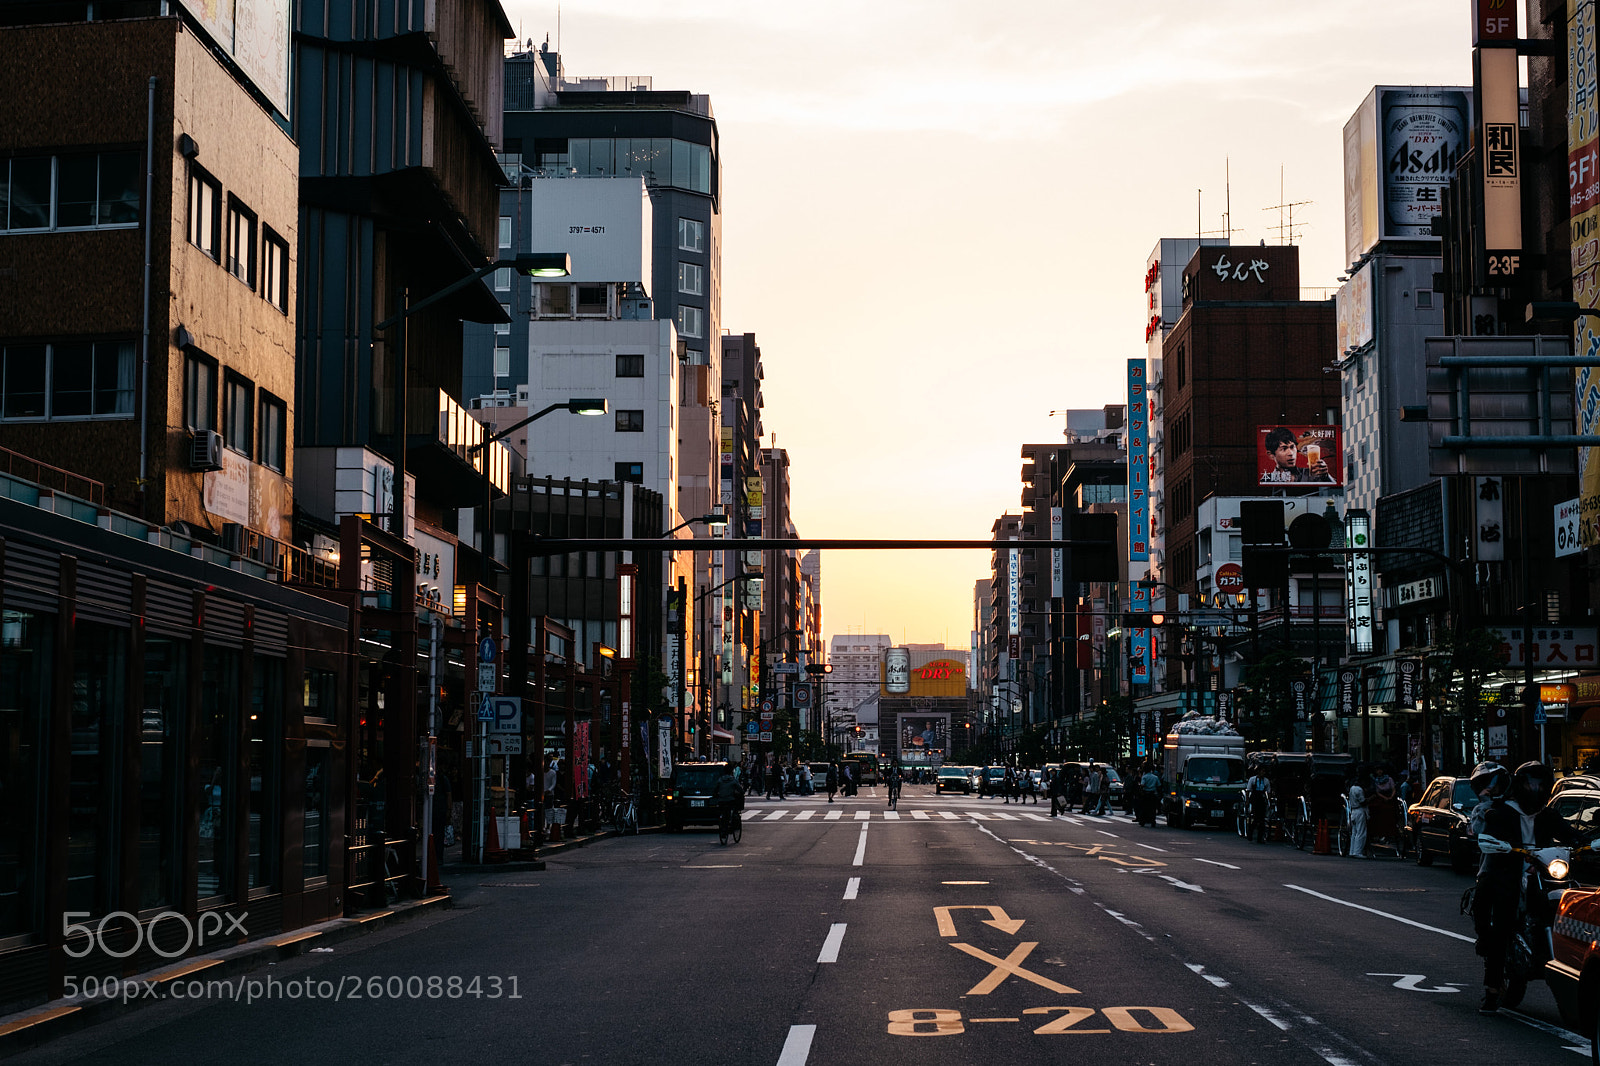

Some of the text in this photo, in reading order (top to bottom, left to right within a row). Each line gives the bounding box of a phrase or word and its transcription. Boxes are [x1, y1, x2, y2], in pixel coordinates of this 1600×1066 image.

[1485, 18, 1509, 34] 5F
[1488, 126, 1514, 175] 和民
[1569, 155, 1590, 191] 5F
[1417, 187, 1437, 201] 生
[1211, 254, 1269, 284] ちんや
[1219, 576, 1243, 587] ガスト
[1511, 630, 1574, 640] 観表参道
[495, 701, 517, 729] P
[887, 1006, 1195, 1036] 8-20
